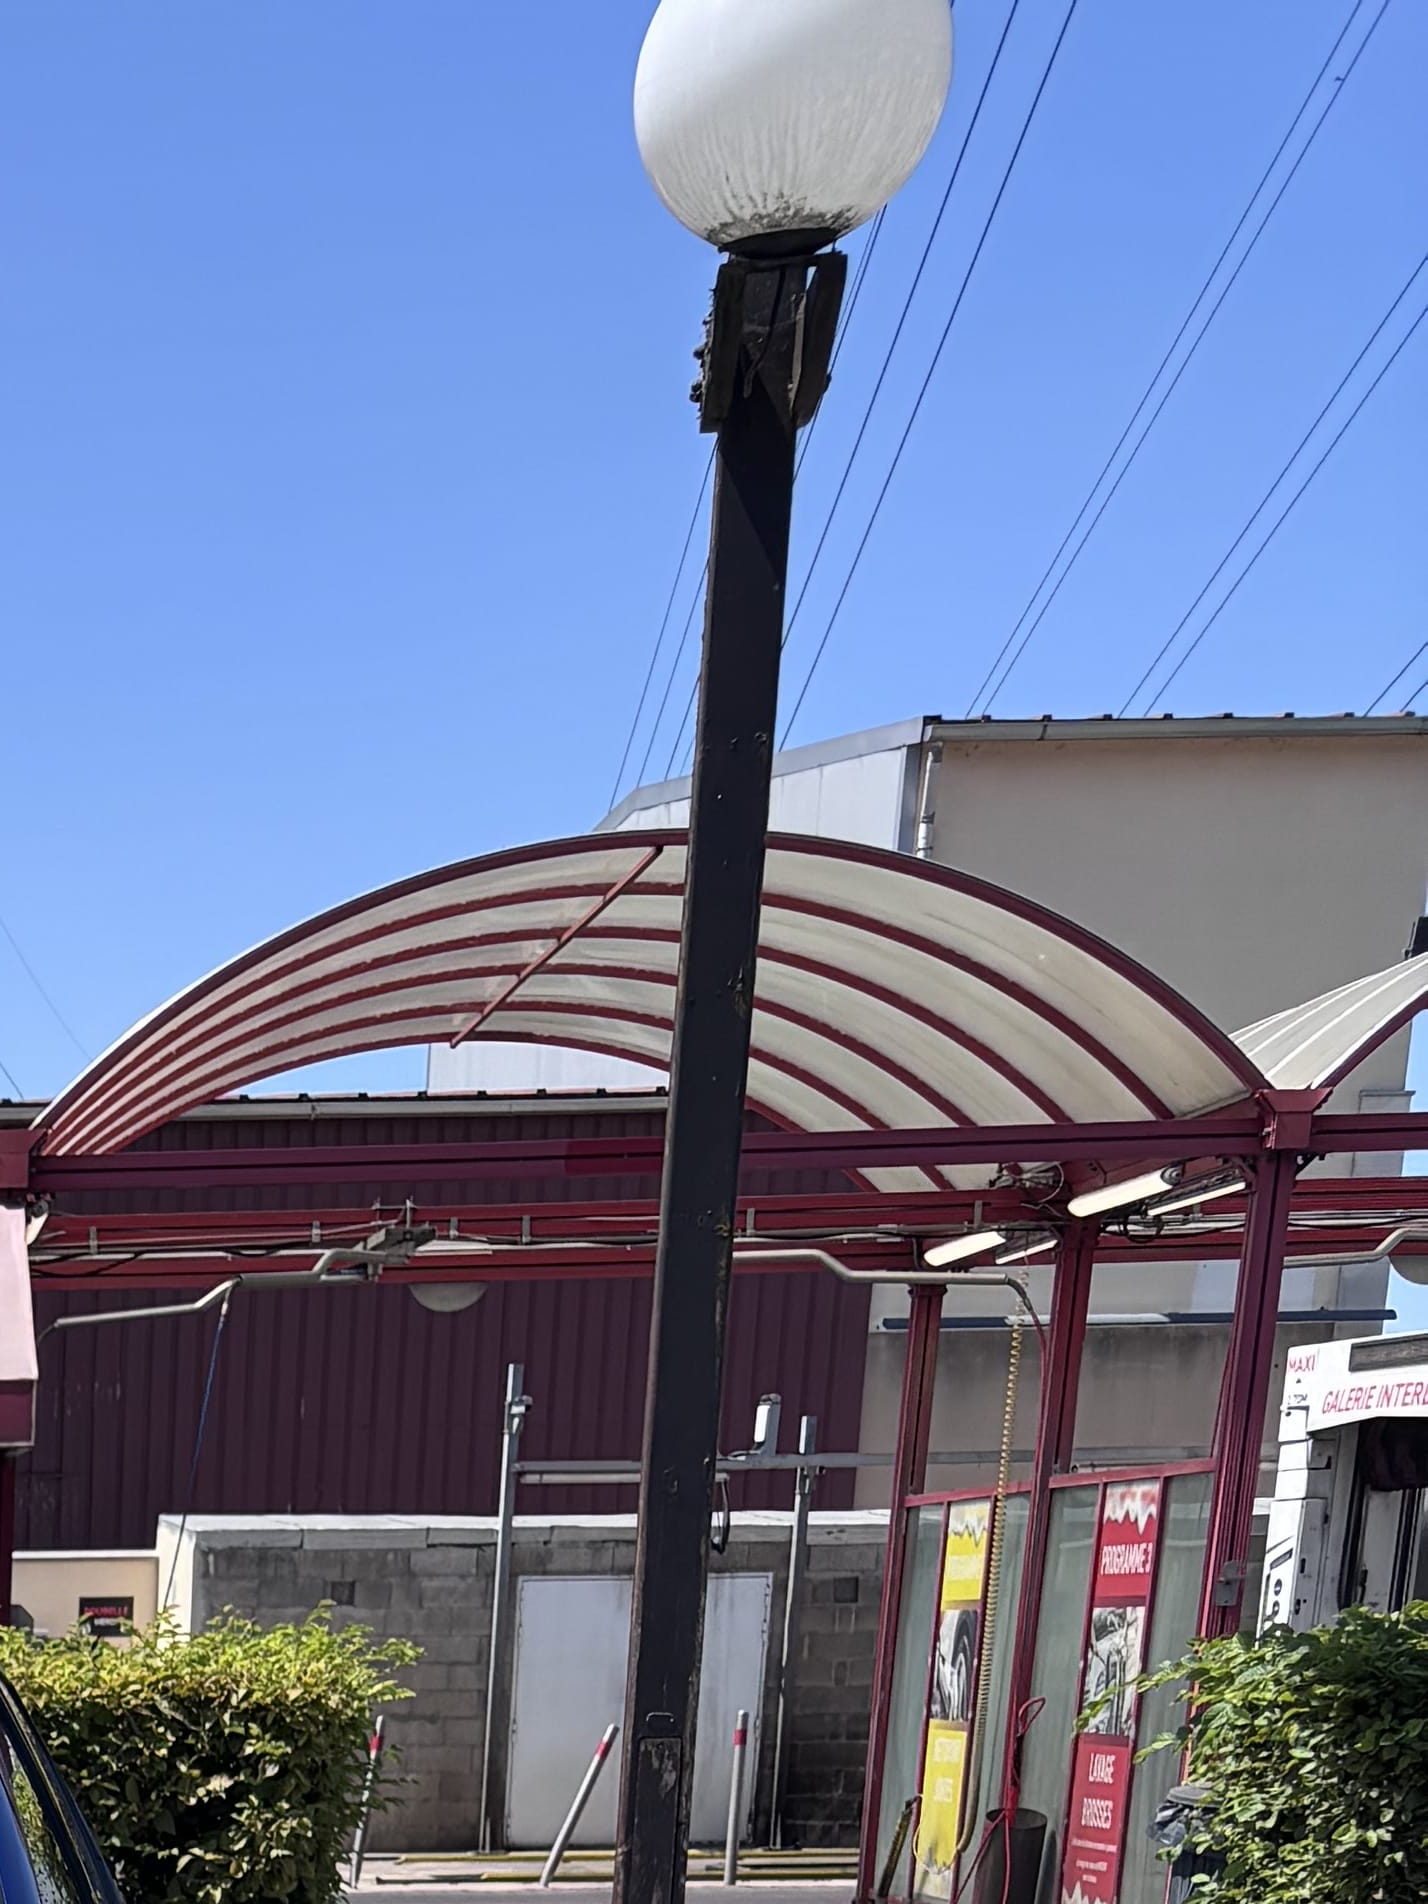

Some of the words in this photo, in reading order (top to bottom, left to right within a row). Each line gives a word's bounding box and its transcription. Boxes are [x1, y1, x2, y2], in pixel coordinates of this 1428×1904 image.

[1289, 1354, 1316, 1373] MAXI
[1322, 1385, 1376, 1414] GALERIE
[1100, 1544, 1147, 1576] PROGRAMME
